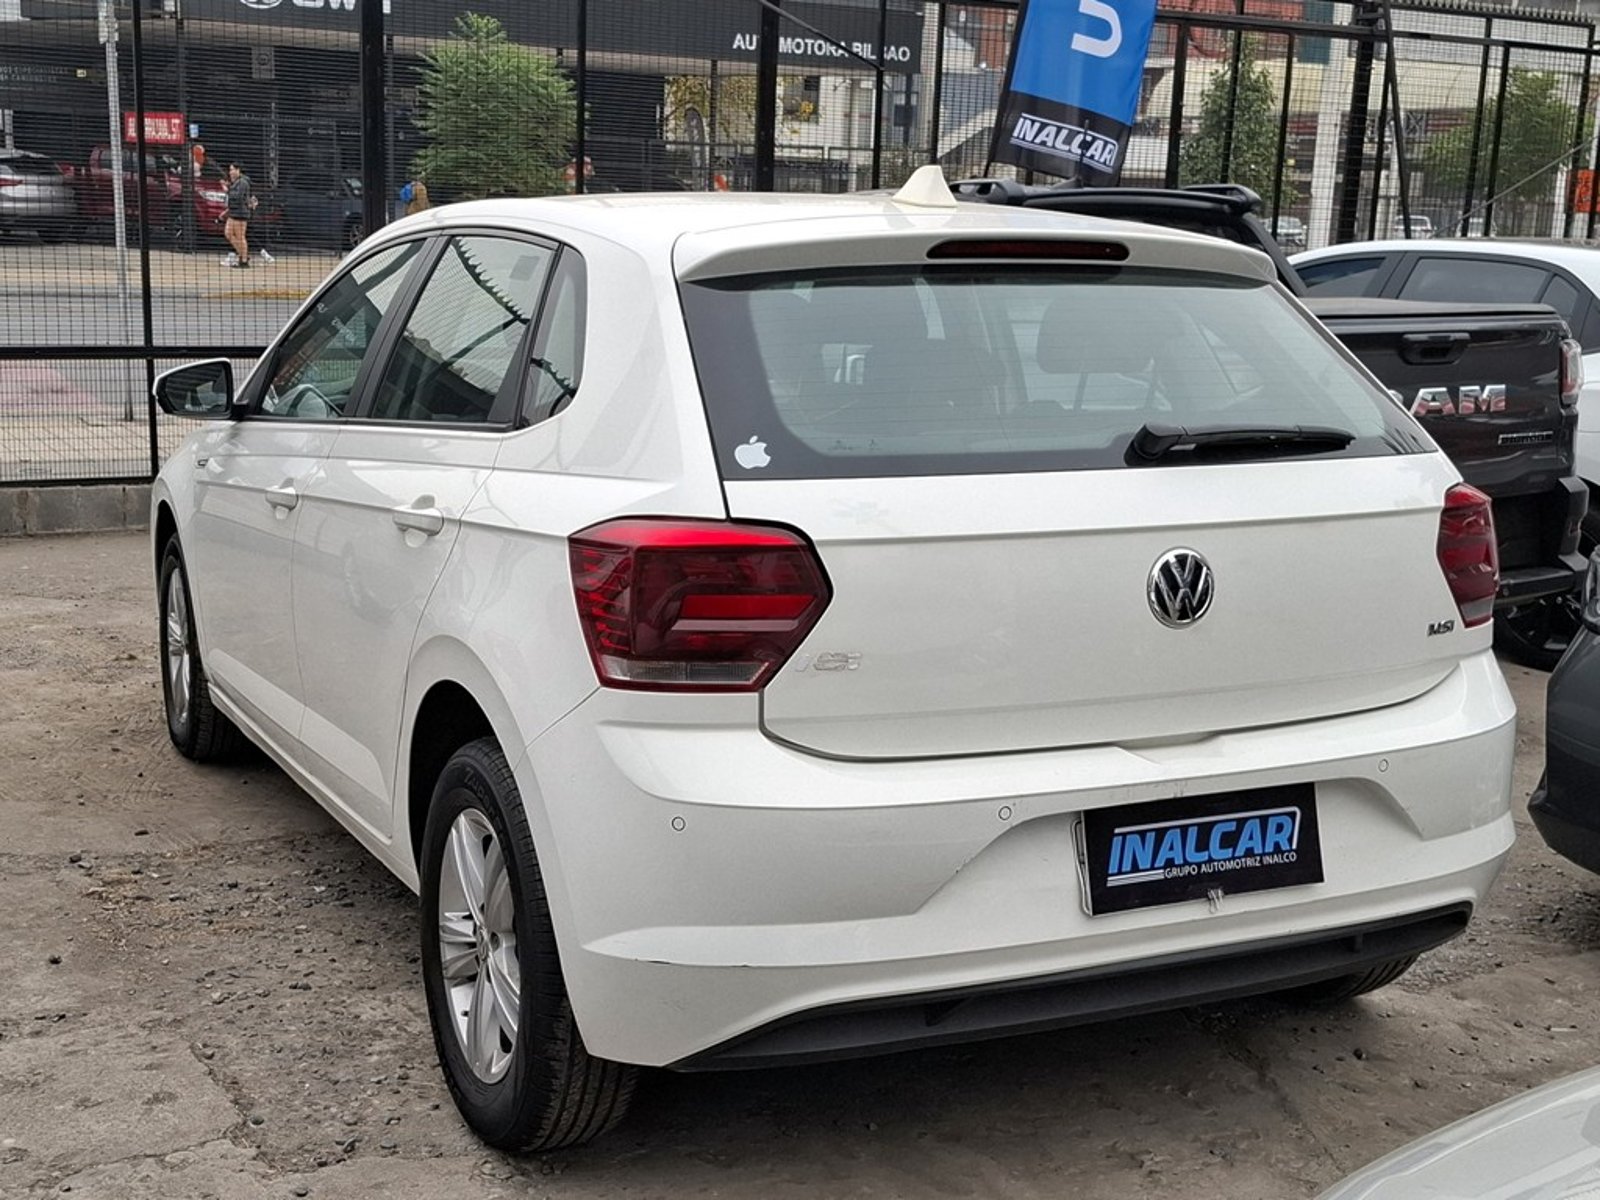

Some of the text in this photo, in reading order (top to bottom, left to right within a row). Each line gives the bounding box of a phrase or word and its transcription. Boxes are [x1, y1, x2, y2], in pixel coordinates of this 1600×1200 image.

[732, 33, 911, 61] AUMOTORA BILAO
[1012, 117, 1115, 166] INALCAR
[1389, 384, 1506, 417] AM
[1108, 815, 1293, 874] INALCAR
[1164, 851, 1298, 879] GRUPO AUTOMOTRIZ INALCO
